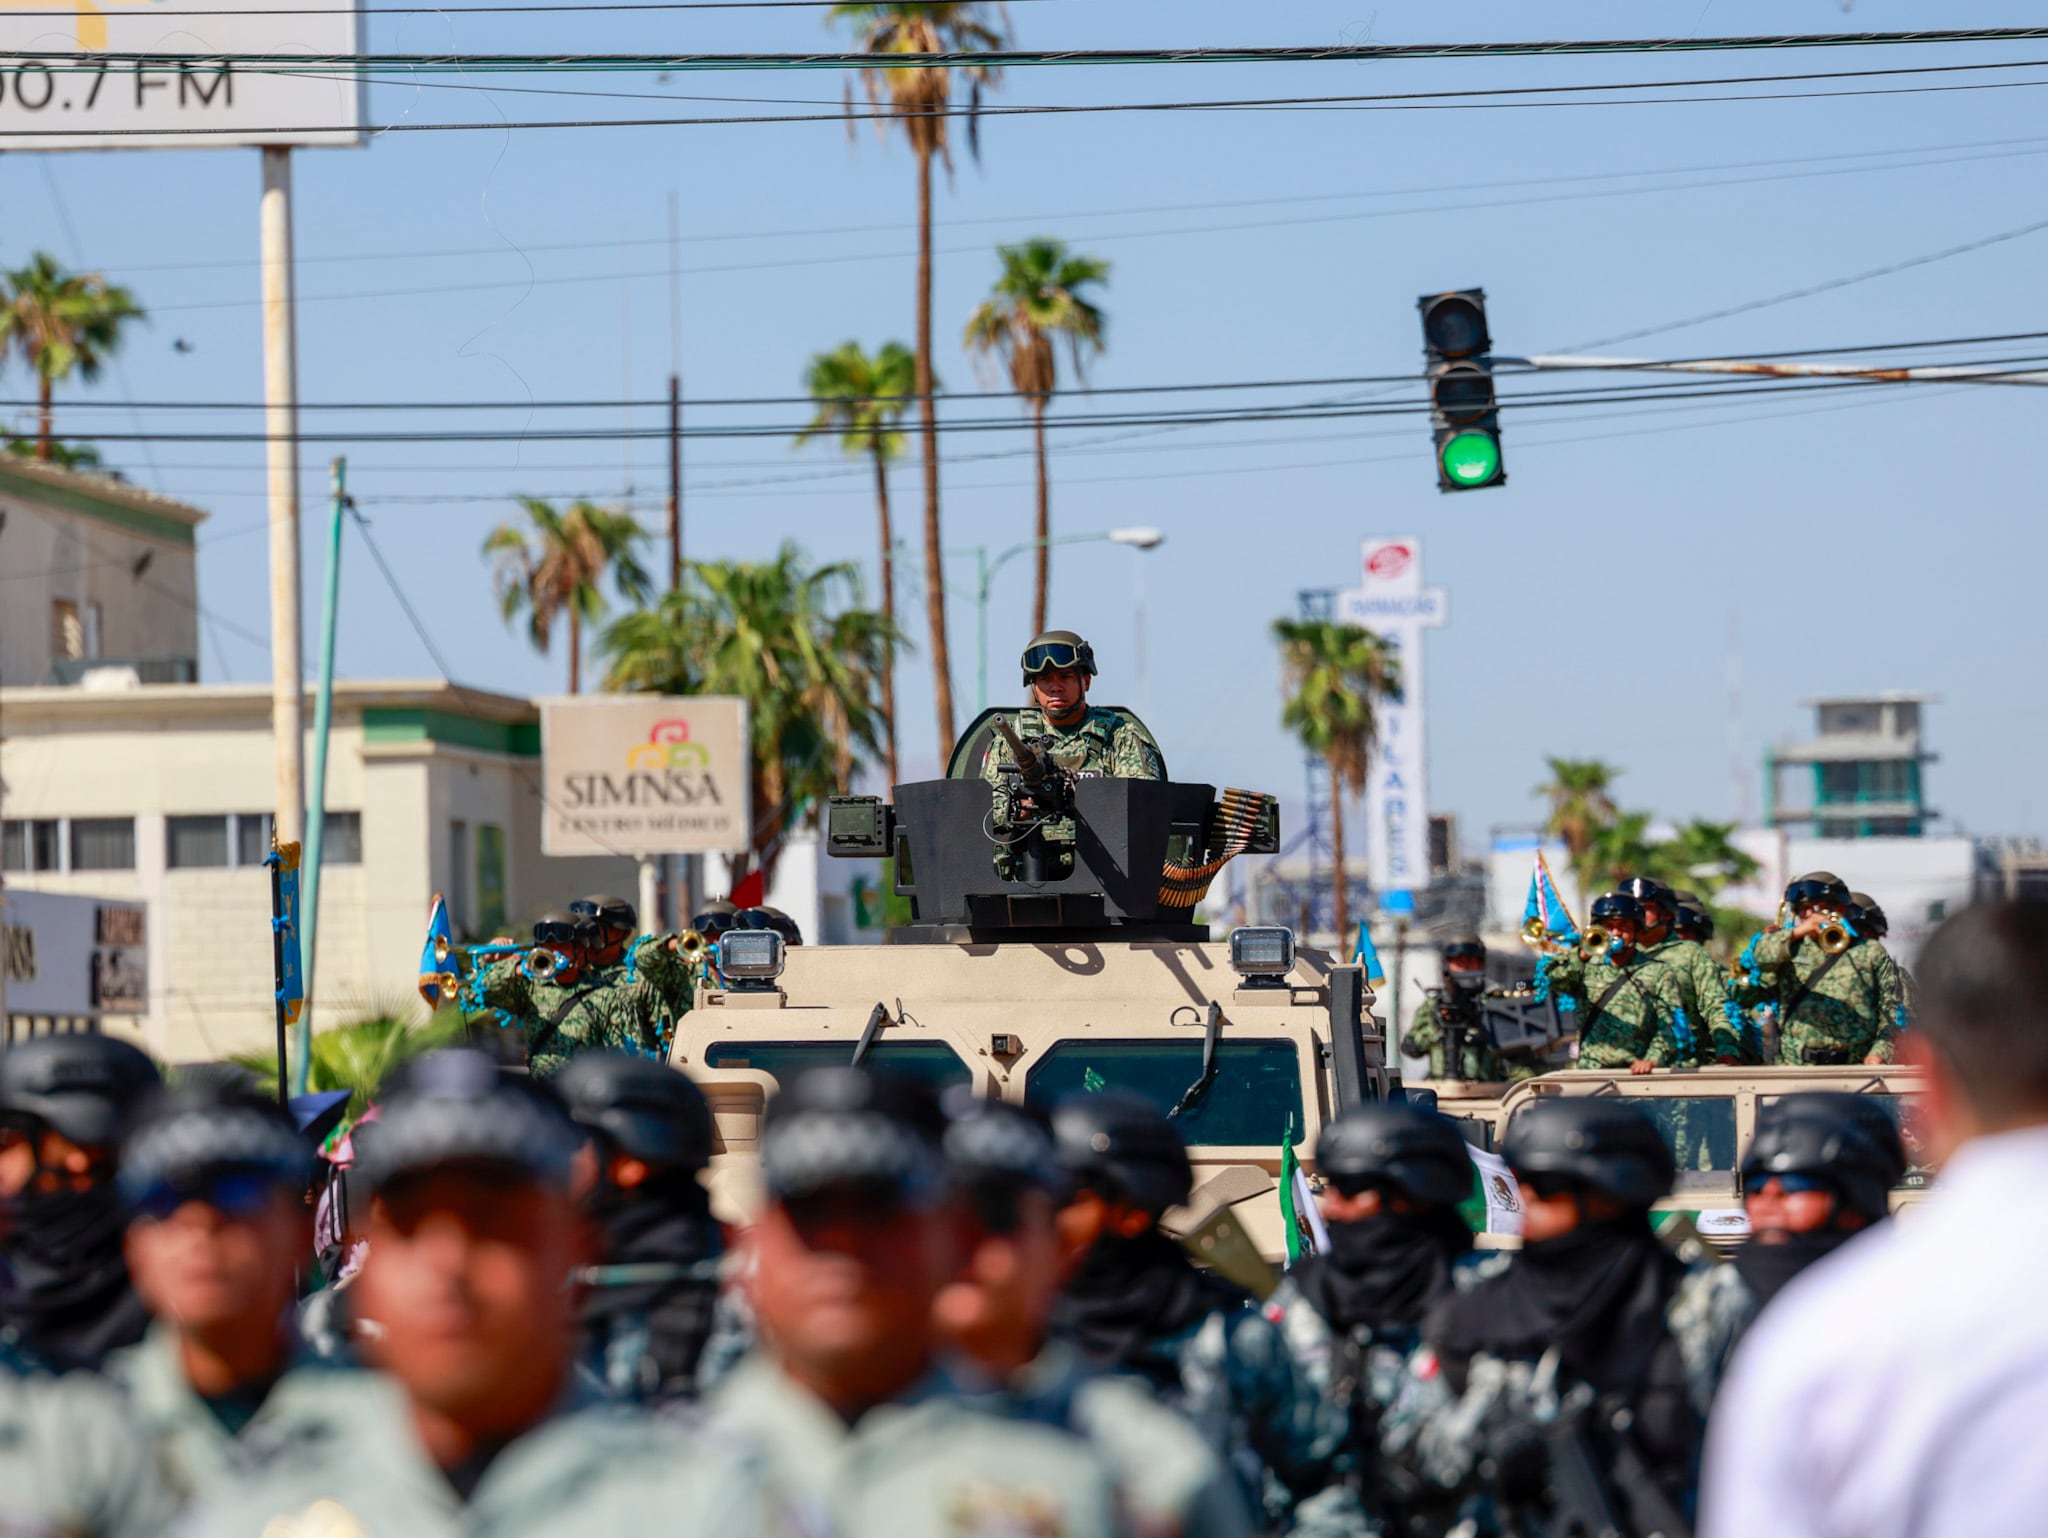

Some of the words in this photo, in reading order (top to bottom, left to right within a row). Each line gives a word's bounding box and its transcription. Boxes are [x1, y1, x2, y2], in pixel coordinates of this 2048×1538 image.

[0, 60, 108, 110] 0.7
[135, 60, 233, 109] FM
[563, 769, 724, 808] SIMNSA
